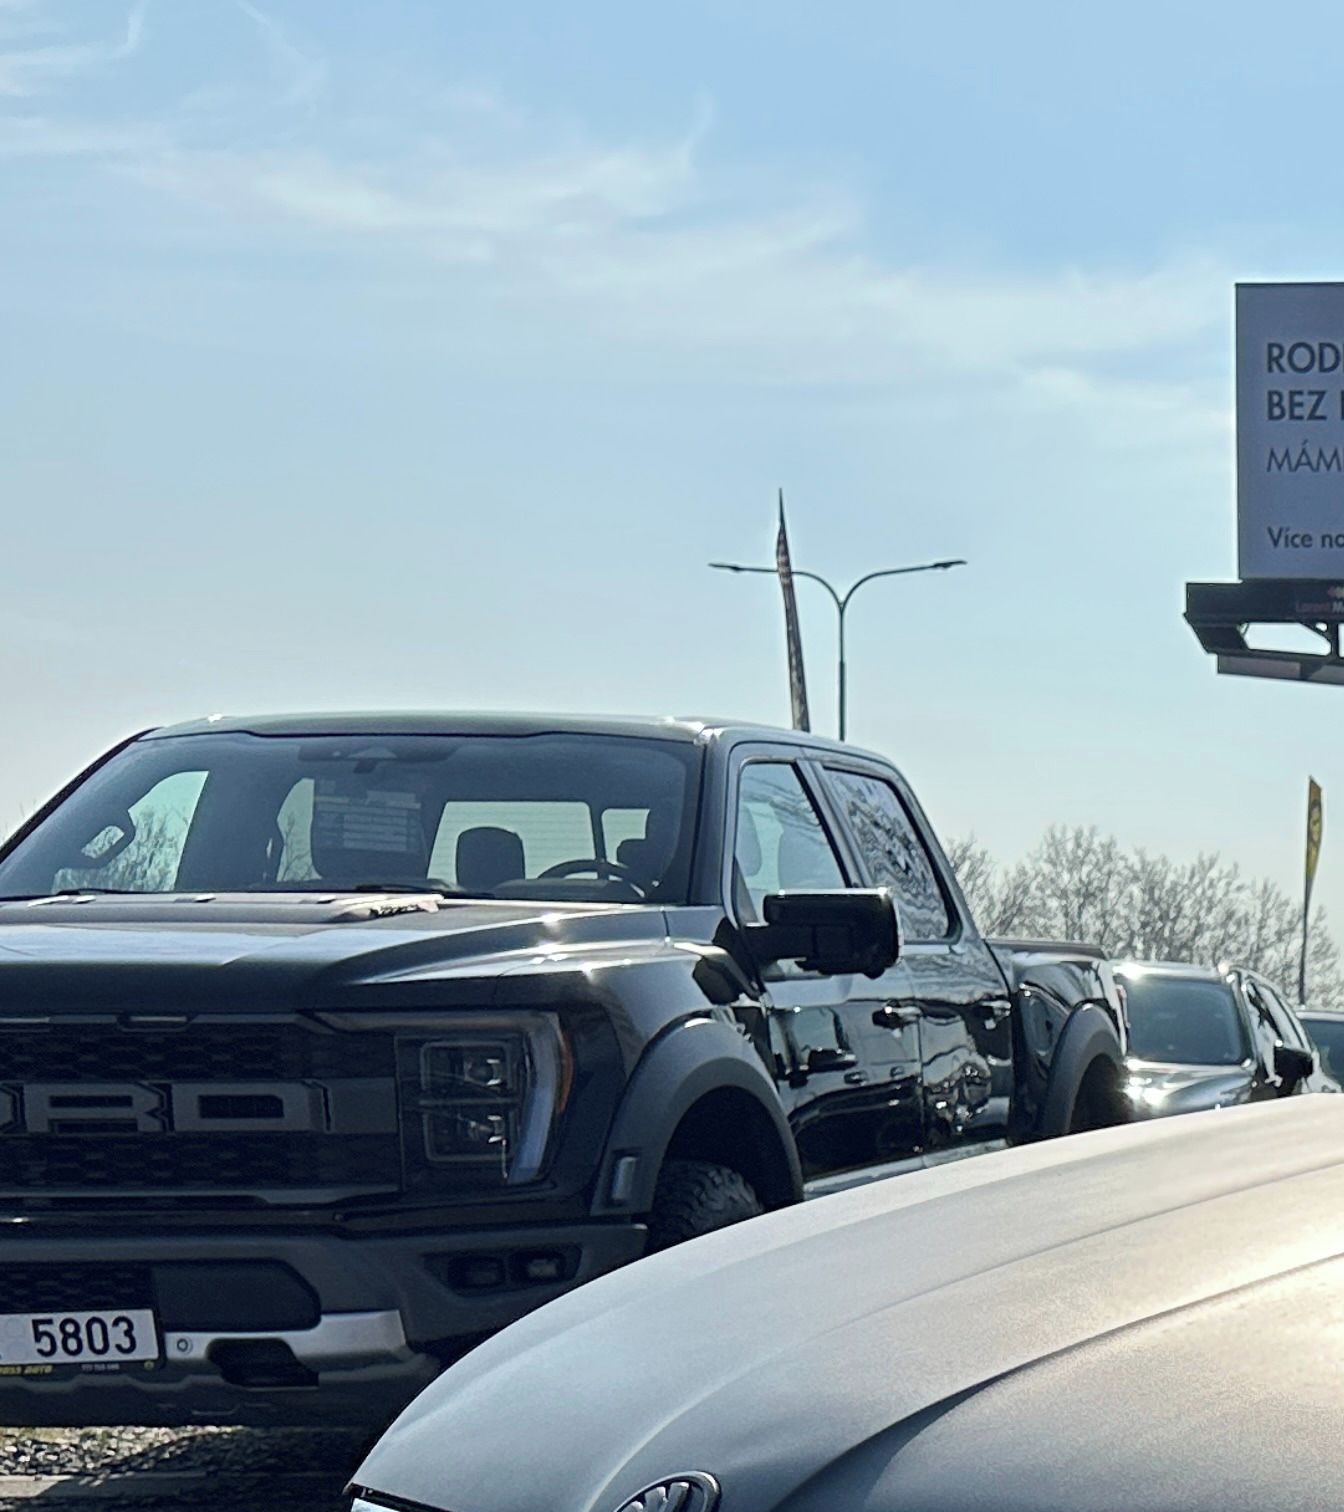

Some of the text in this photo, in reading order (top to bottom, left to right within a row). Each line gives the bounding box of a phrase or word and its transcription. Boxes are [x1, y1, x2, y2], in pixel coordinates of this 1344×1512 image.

[1266, 389, 1327, 421] BEZ
[1267, 525, 1313, 549] Více
[0, 1081, 312, 1132] RD
[31, 1316, 137, 1358] 5803
